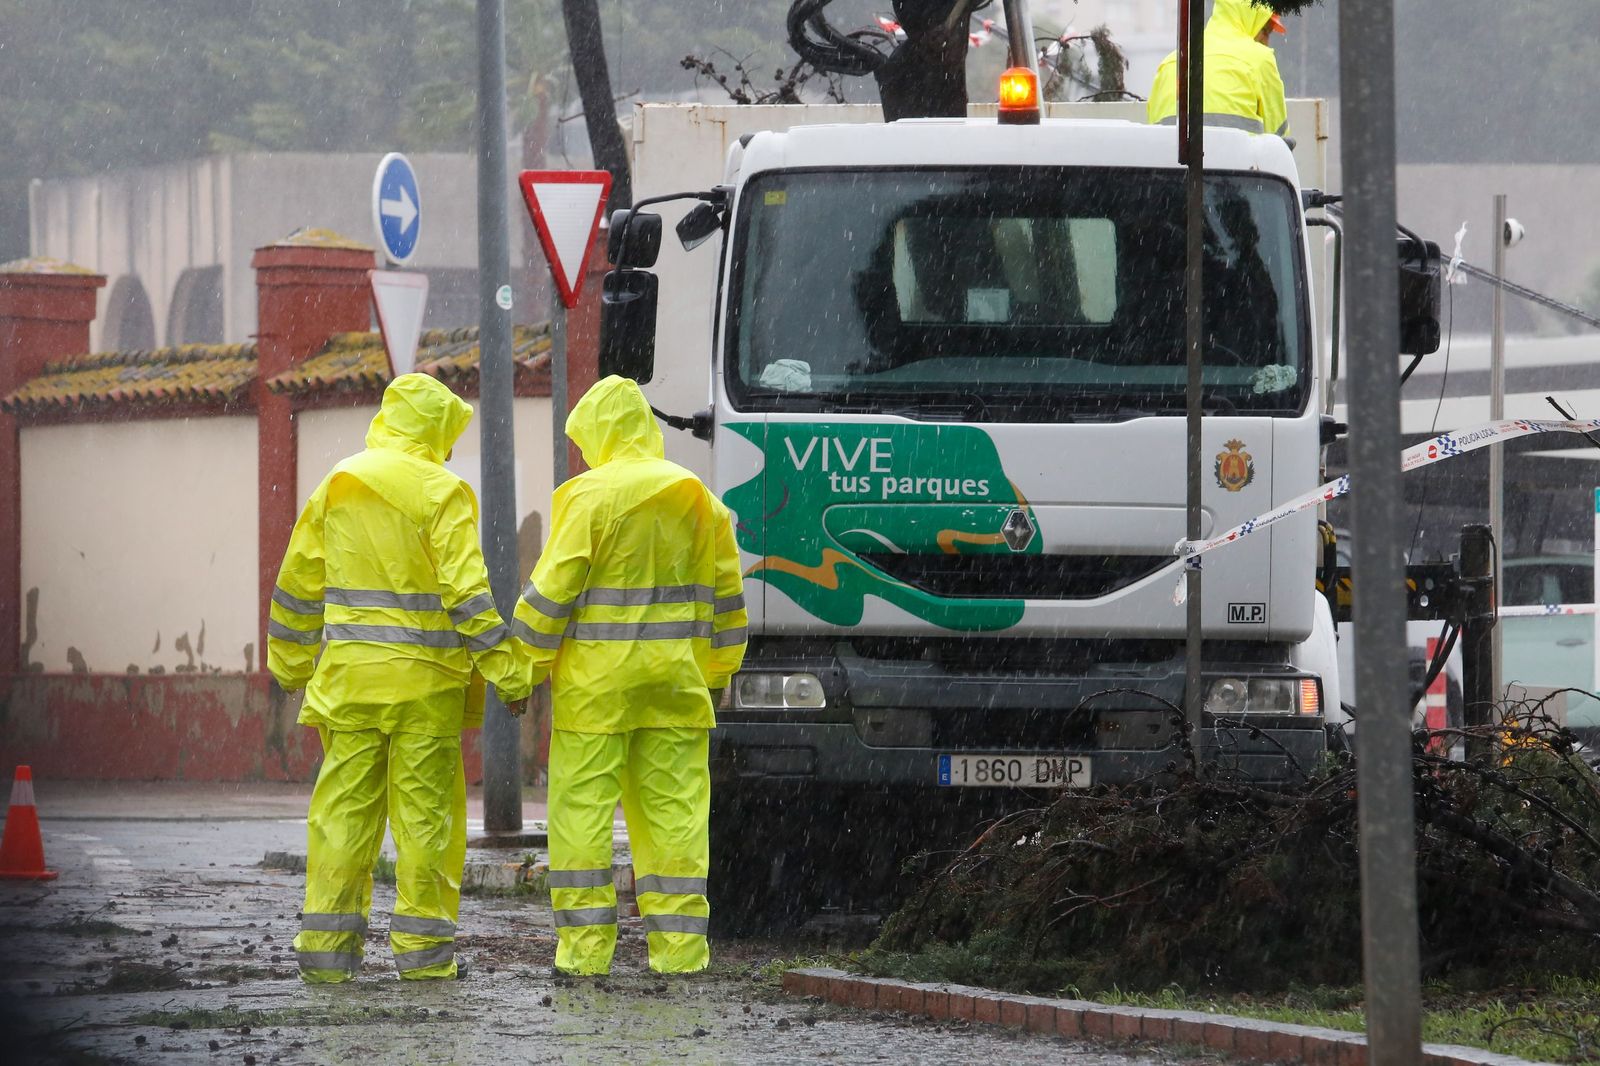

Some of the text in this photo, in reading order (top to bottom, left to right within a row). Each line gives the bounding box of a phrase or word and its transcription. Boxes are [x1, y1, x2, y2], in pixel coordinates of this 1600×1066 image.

[1480, 427, 1498, 441] LOCAL
[784, 436, 892, 473] VIVE
[828, 471, 990, 501] tus parques
[1231, 605, 1263, 621] M.P.
[941, 758, 1083, 783] E 1860 DMP
